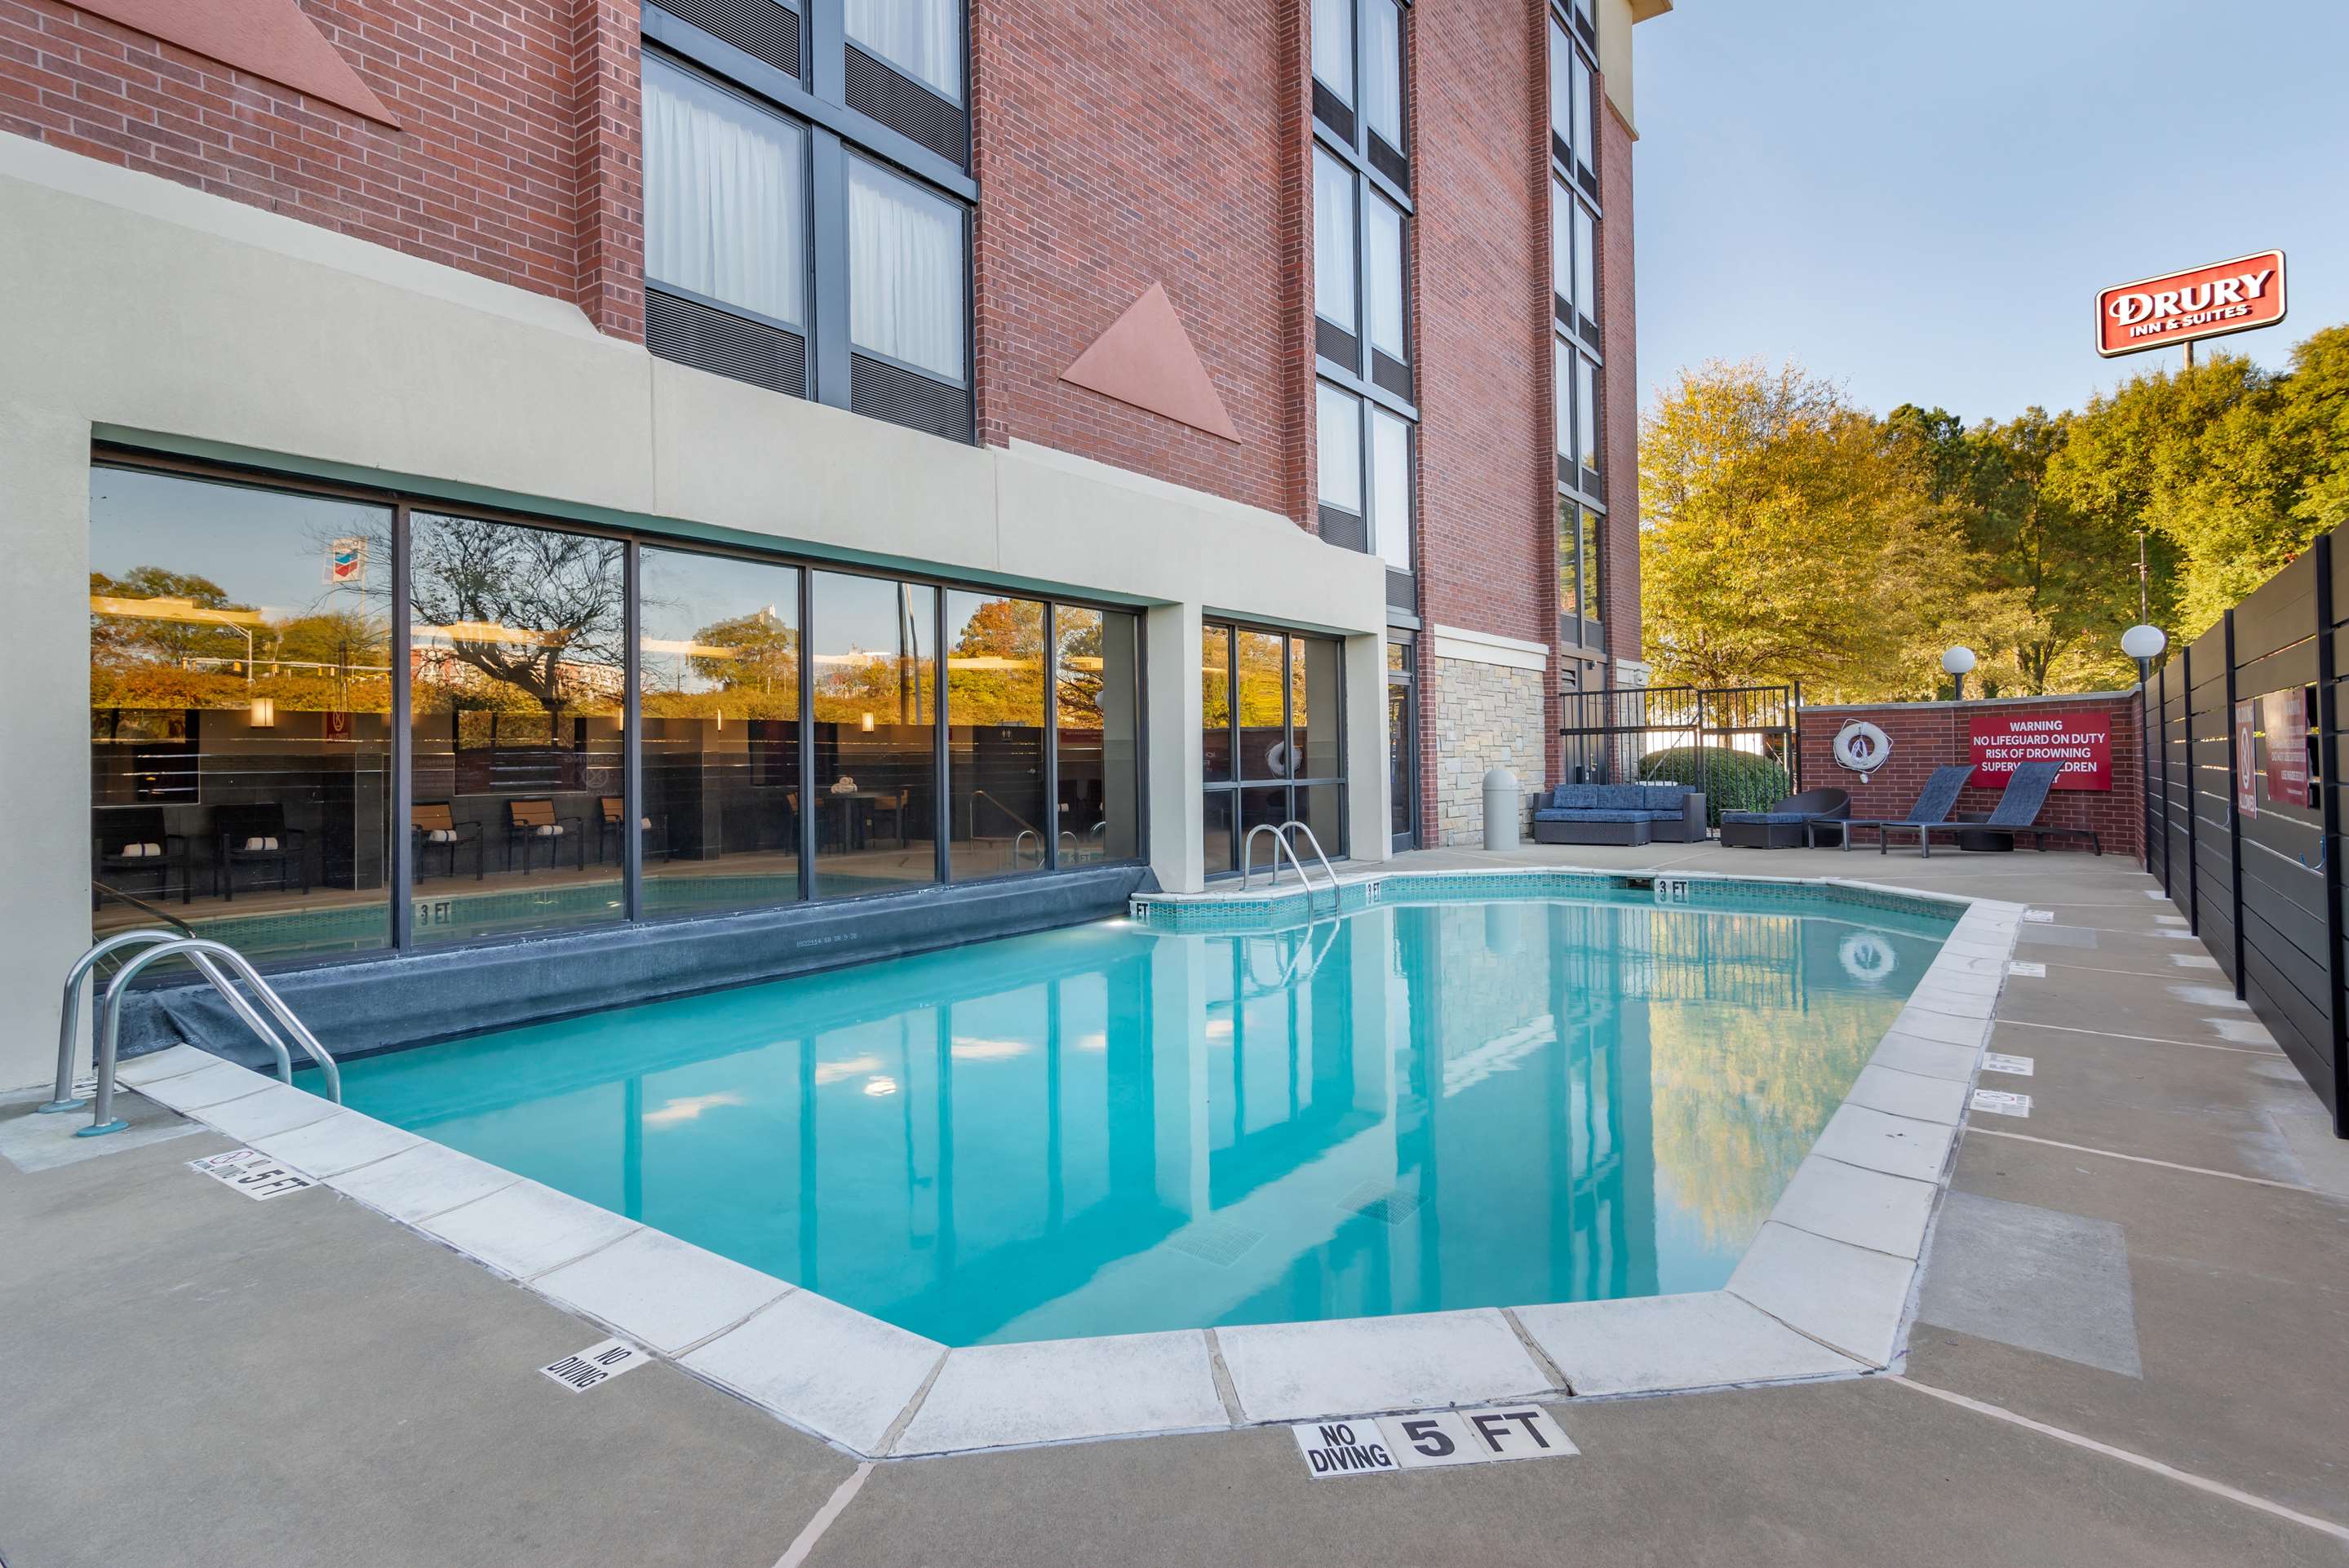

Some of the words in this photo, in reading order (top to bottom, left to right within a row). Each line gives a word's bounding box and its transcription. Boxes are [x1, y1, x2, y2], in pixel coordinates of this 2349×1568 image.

[2108, 269, 2272, 326] DRURY
[2130, 321, 2161, 338] INN
[2166, 319, 2179, 330] &
[2182, 304, 2248, 326] SUITES
[2010, 720, 2063, 732] WARNING
[1973, 736, 1989, 746] NO
[1991, 735, 2049, 746] LIFEGUARD
[2051, 734, 2069, 744] ON
[2072, 733, 2105, 744] DUTY
[1986, 749, 2008, 758] RISK
[2010, 748, 2024, 758] OF
[2027, 747, 2090, 758] DROWNING
[1981, 762, 2021, 772] SUPERV
[1367, 884, 1372, 895] 3
[1373, 882, 1380, 895] FT
[1660, 880, 1667, 893] 3
[1673, 881, 1686, 893] FT
[1136, 902, 1148, 915] FT
[237, 1169, 285, 1183] 5
[251, 1177, 310, 1195] FT
[593, 1346, 632, 1365] NO
[547, 1356, 609, 1388] DIVING
[1319, 1424, 1356, 1447] NO
[1401, 1420, 1456, 1457] 5
[1471, 1411, 1550, 1452] FT
[1307, 1443, 1392, 1472] DIVING
